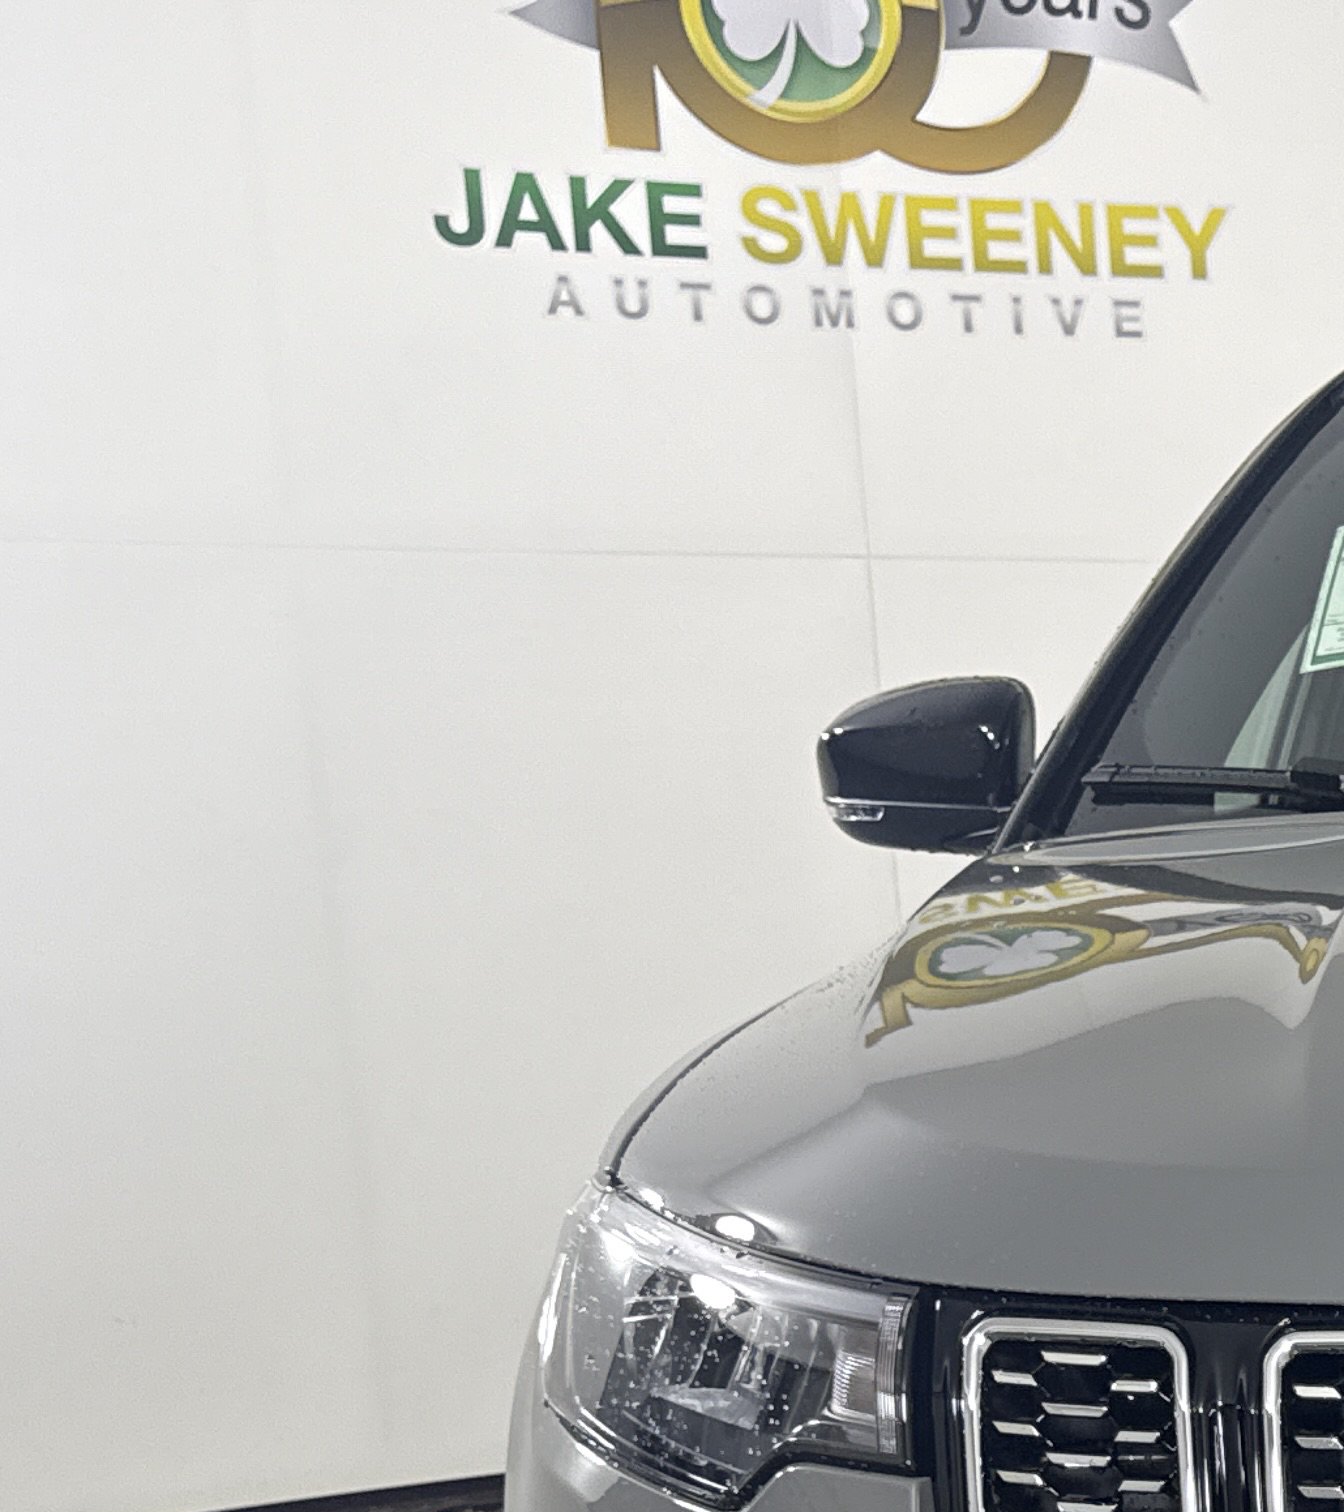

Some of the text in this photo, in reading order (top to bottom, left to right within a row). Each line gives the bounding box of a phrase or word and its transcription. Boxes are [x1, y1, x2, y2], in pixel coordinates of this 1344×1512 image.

[434, 167, 1227, 280] JAKE SWEENEY
[547, 275, 1145, 339] AUTOMOTIVE
